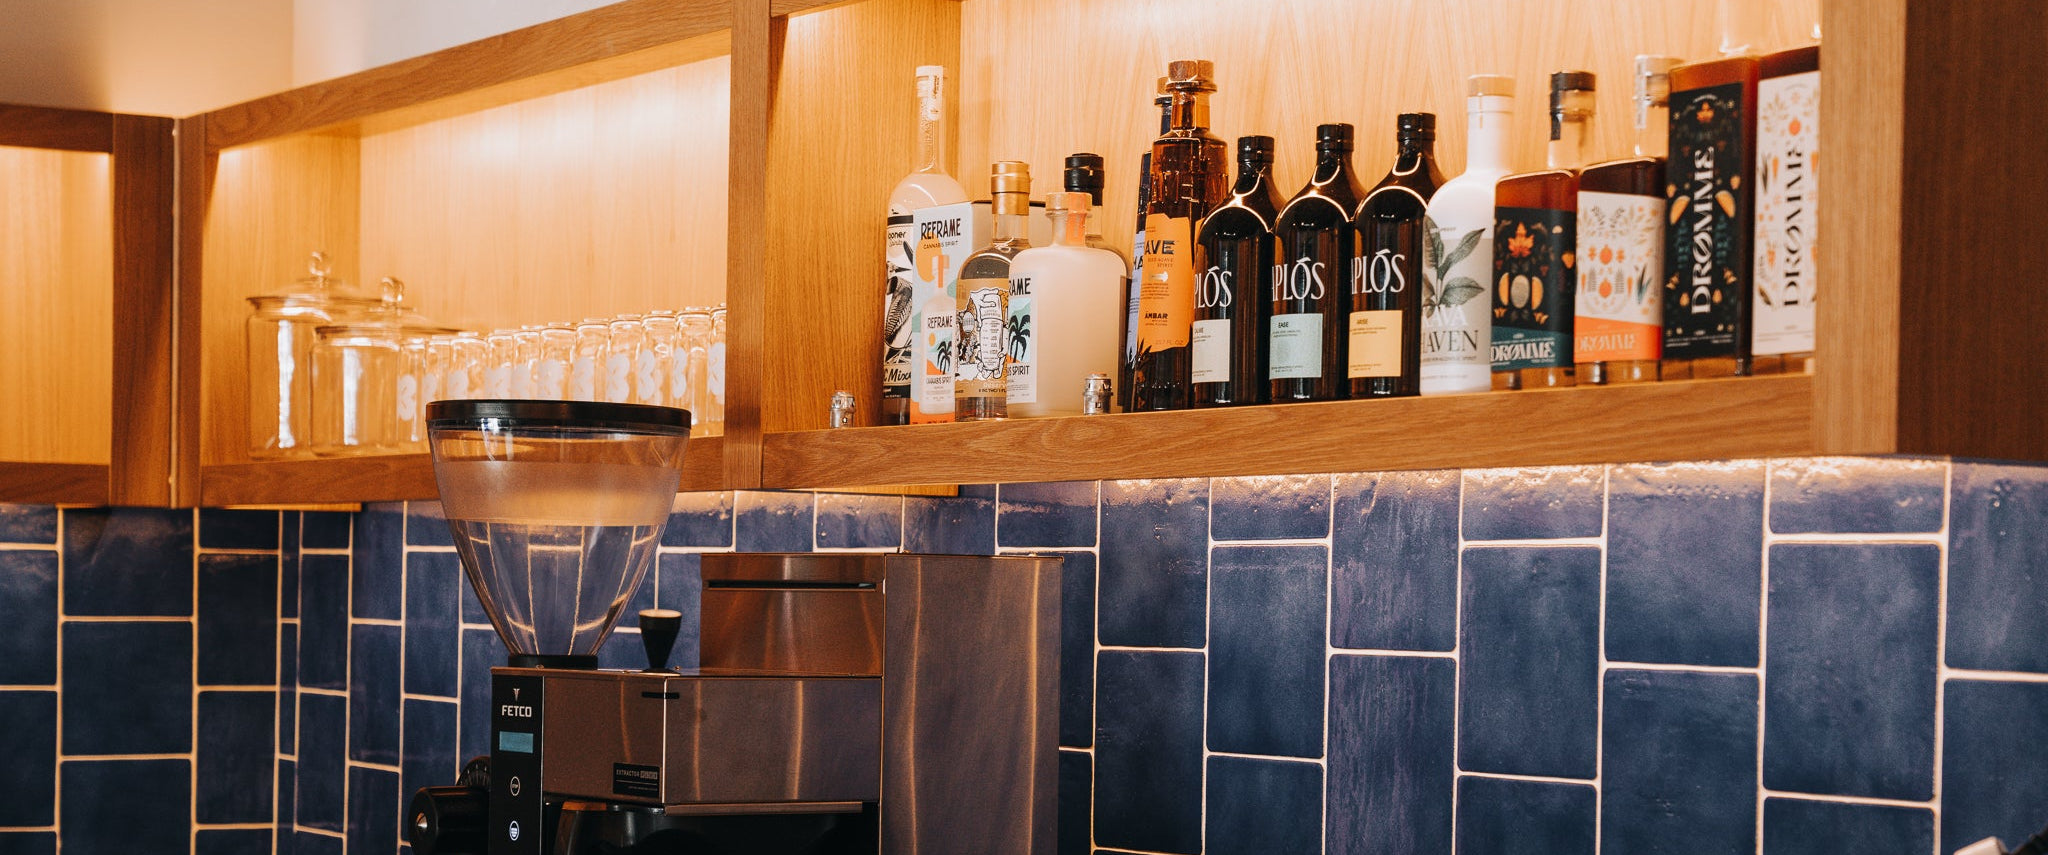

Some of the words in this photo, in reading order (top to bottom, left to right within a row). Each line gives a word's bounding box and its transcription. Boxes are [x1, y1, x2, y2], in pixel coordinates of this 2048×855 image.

[920, 218, 961, 240] REFRAME
[927, 315, 953, 329] REFRAME
[501, 705, 532, 717] FETCO
[616, 769, 640, 777] EXTRACTOR
